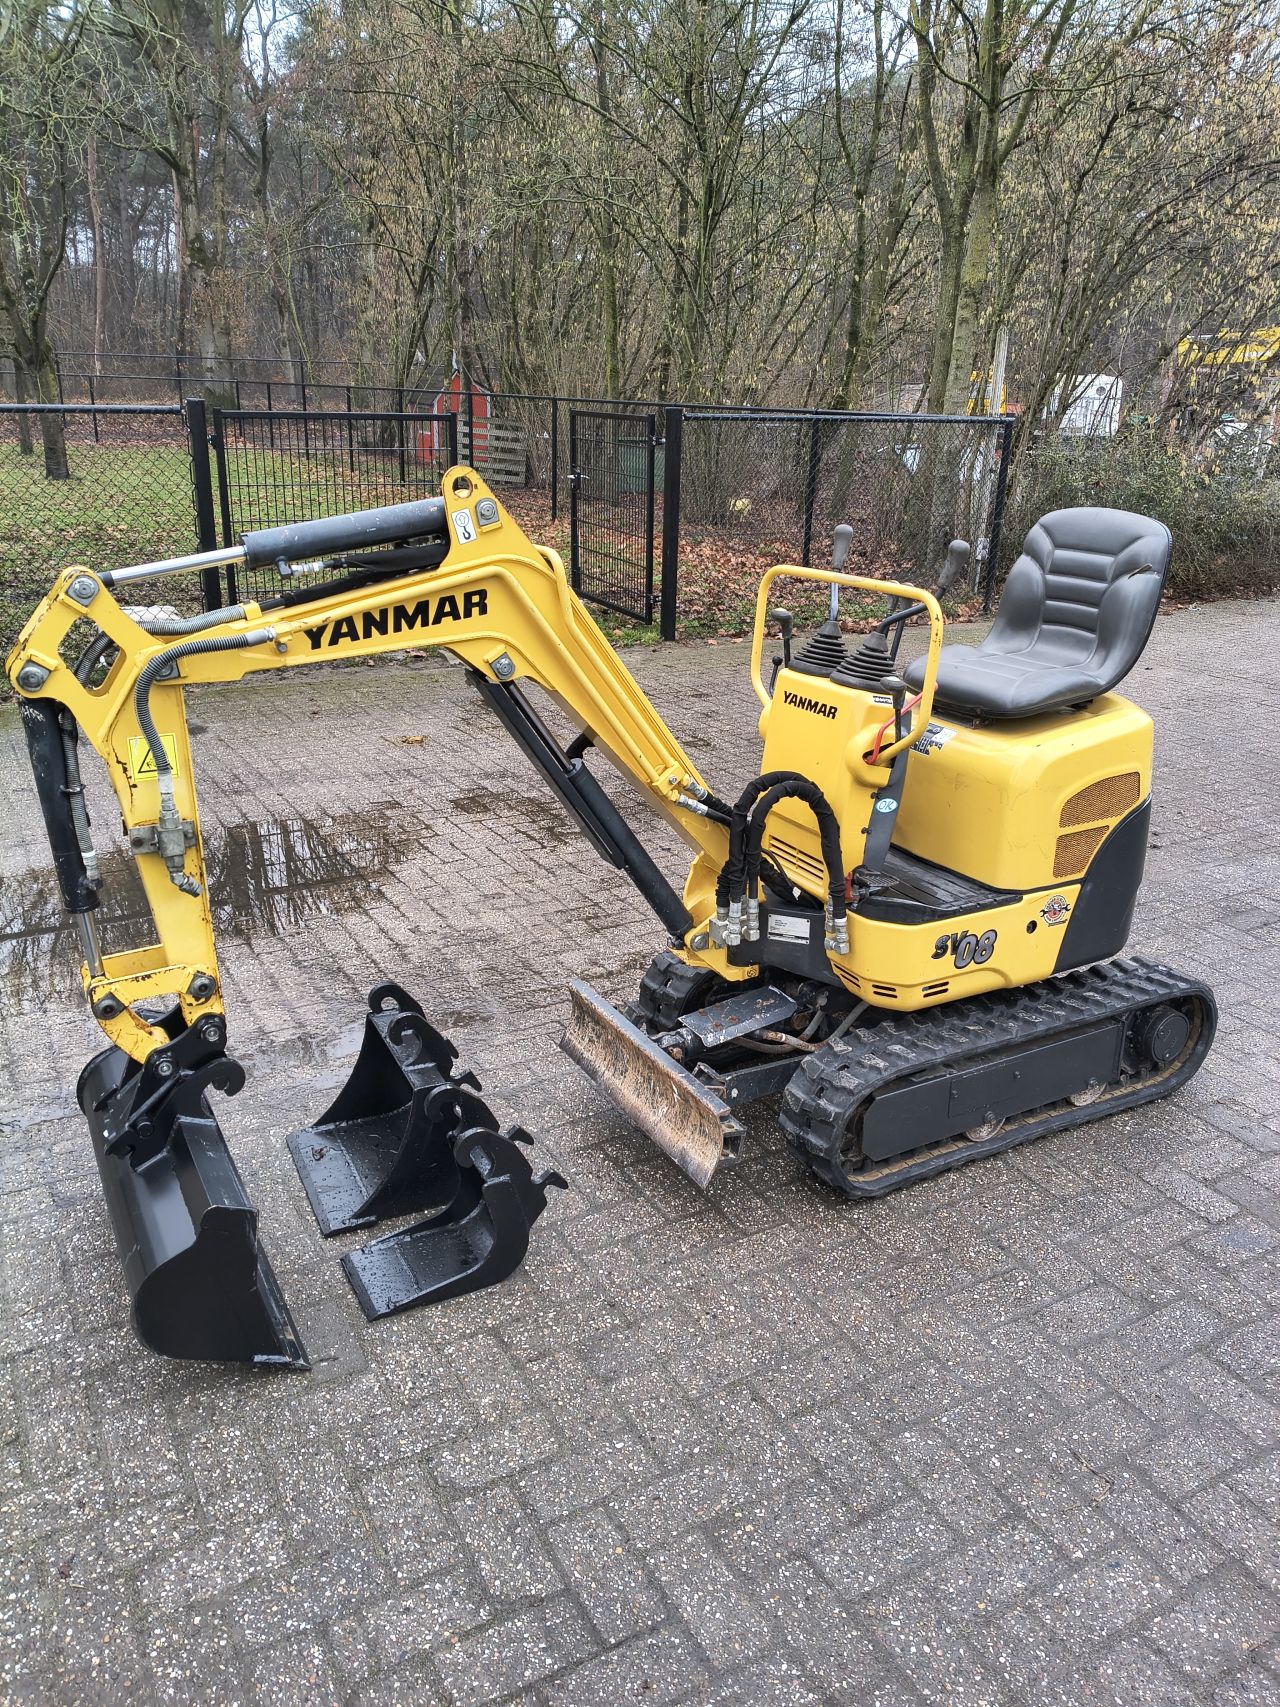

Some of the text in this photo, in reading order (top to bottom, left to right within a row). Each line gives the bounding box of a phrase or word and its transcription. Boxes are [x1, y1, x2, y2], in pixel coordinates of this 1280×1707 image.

[304, 589, 488, 650] YANMAR
[784, 690, 838, 720] YANMAR
[879, 800, 895, 811] OK
[931, 929, 998, 969] SV08
